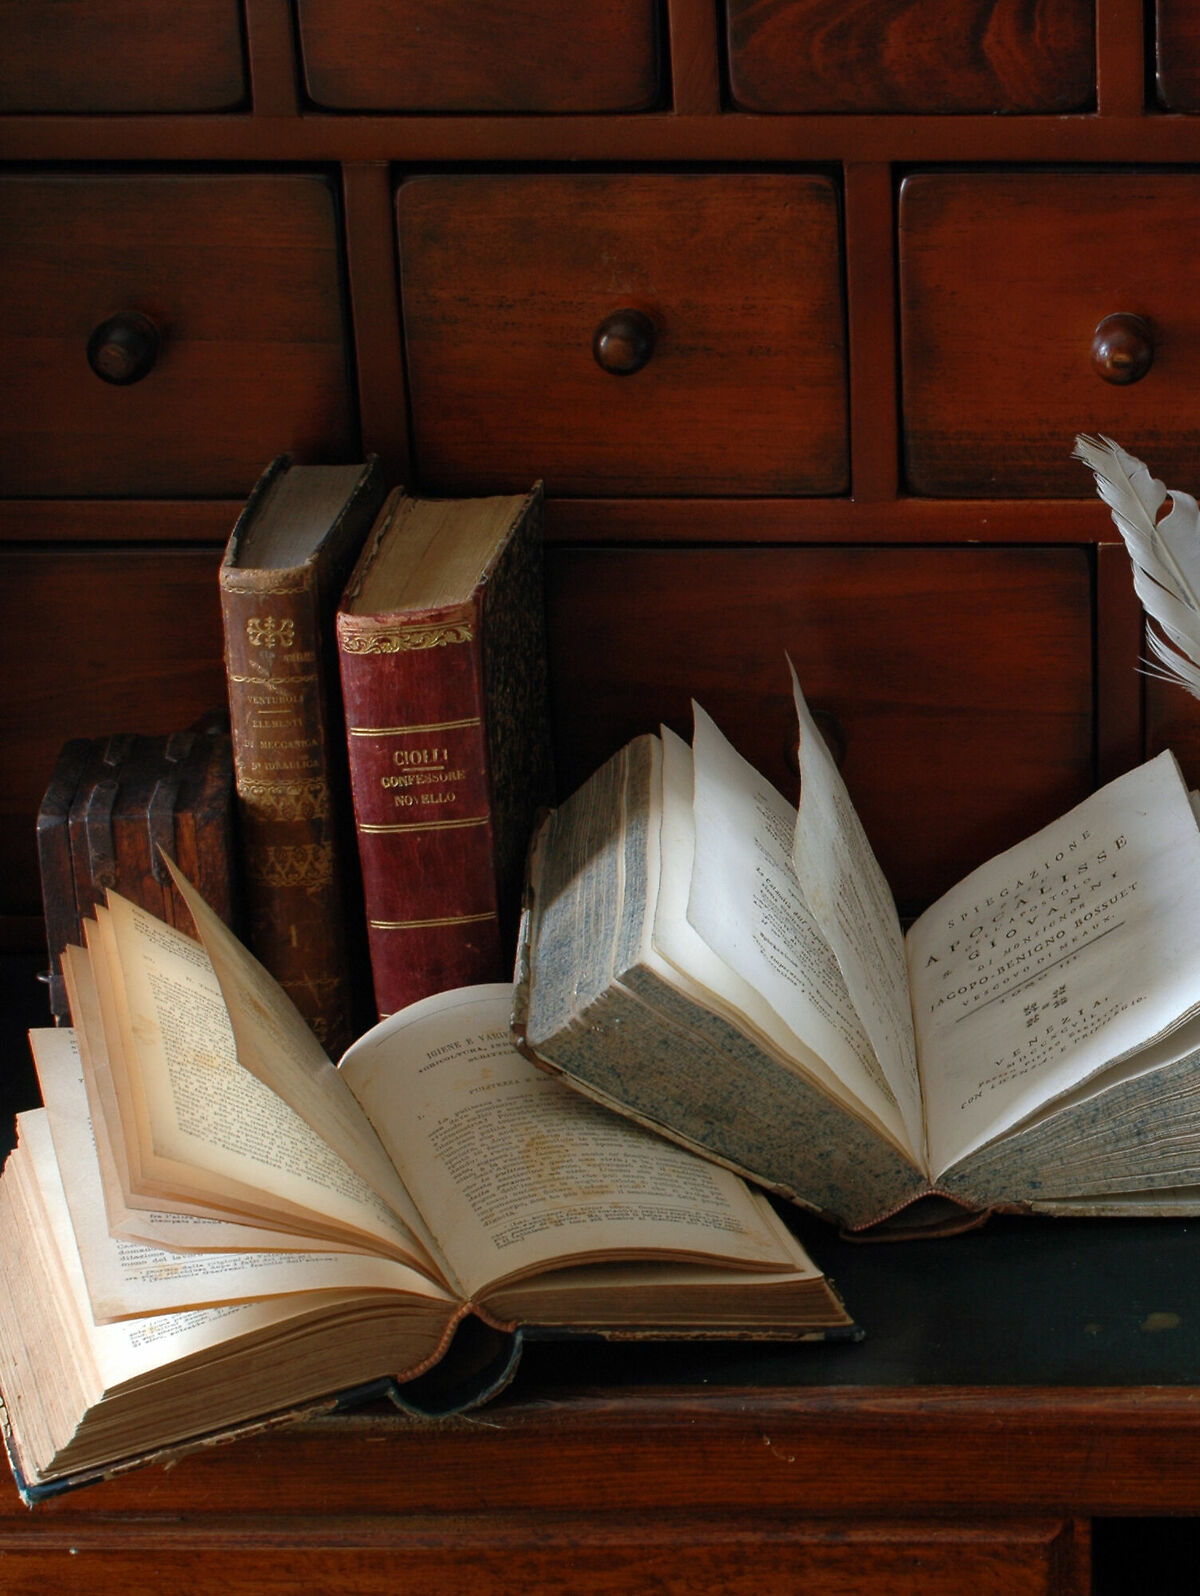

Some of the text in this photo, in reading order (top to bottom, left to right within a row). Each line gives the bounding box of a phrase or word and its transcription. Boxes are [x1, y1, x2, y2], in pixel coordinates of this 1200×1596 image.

[381, 770, 466, 789] CONFESSORE
[925, 835, 1128, 968] APOCALISSE
[947, 830, 1091, 929] SPIEGAZIONE
[968, 872, 1119, 962] GIOVANNI
[1074, 881, 1138, 929] BOSSUET
